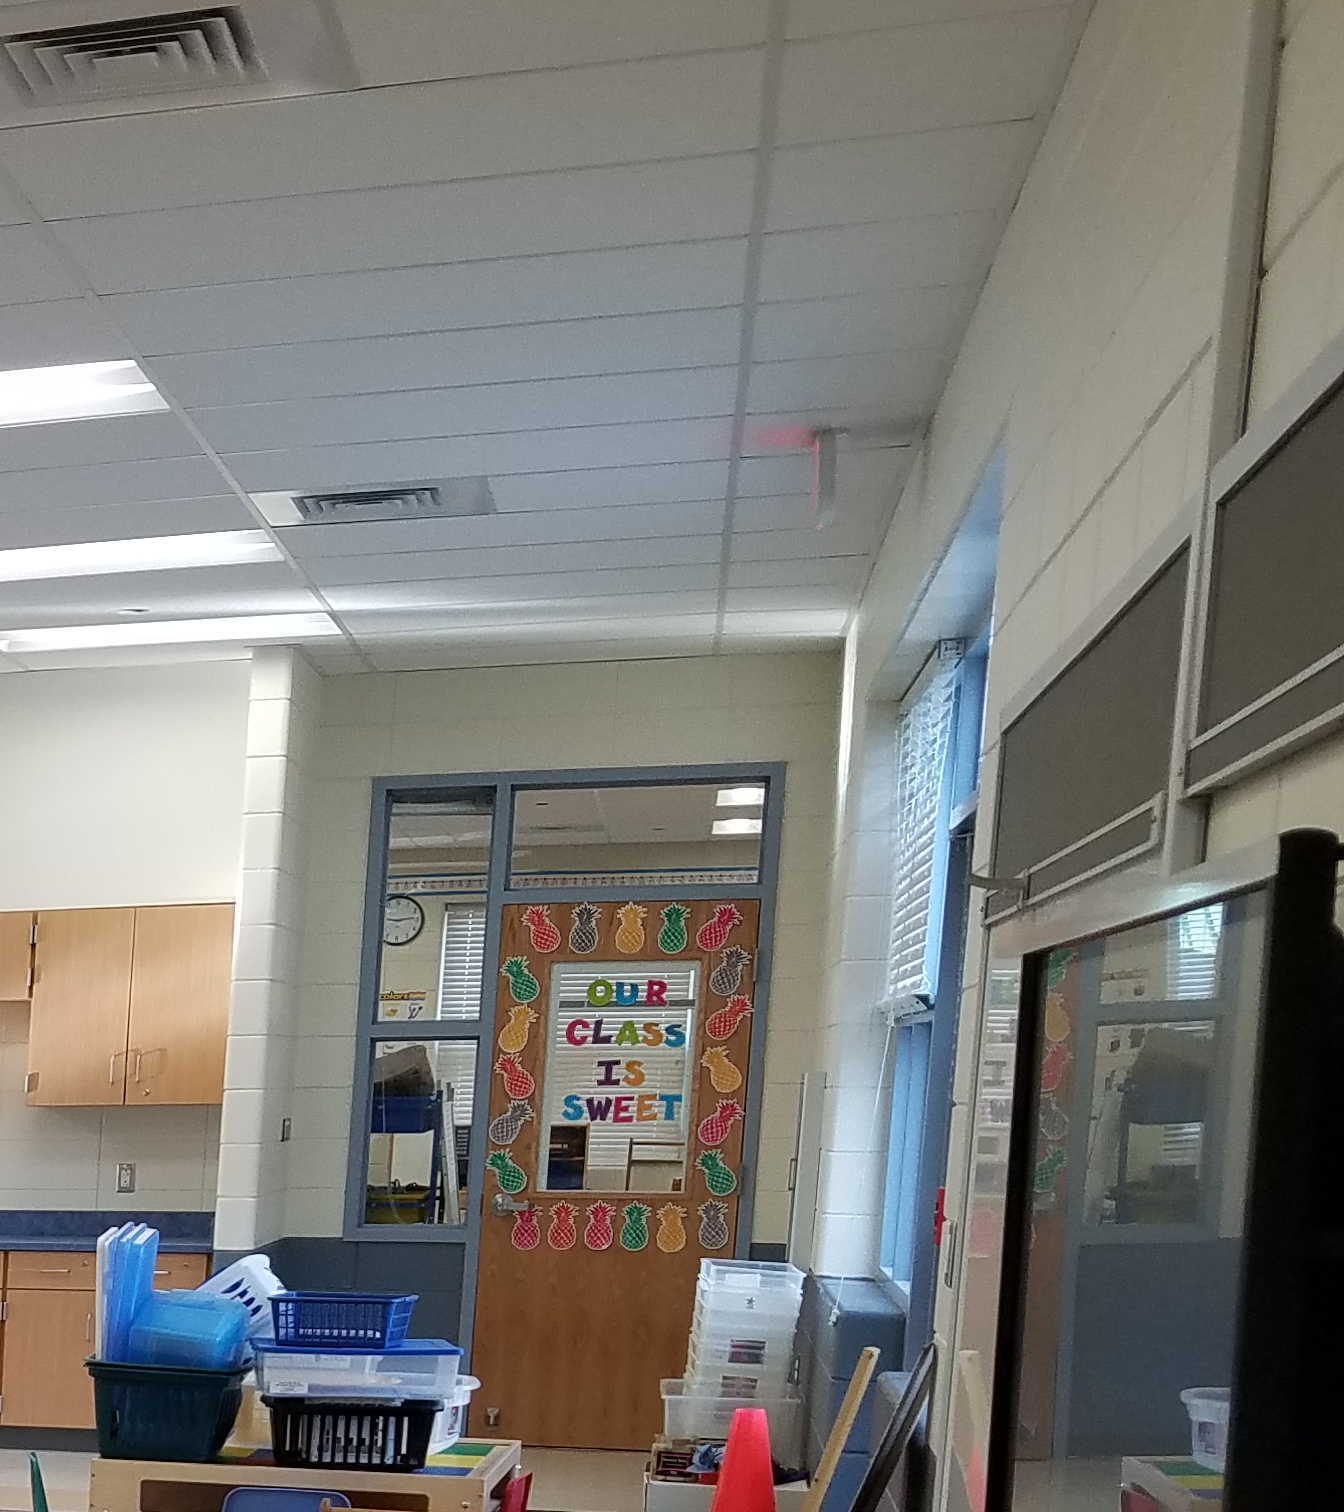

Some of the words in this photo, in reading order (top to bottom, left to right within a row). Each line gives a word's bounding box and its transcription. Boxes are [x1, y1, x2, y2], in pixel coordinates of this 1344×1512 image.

[587, 978, 668, 1006] OUR
[565, 1019, 686, 1047] CLASS
[596, 1059, 646, 1087] IS
[561, 1093, 683, 1123] SWEET
